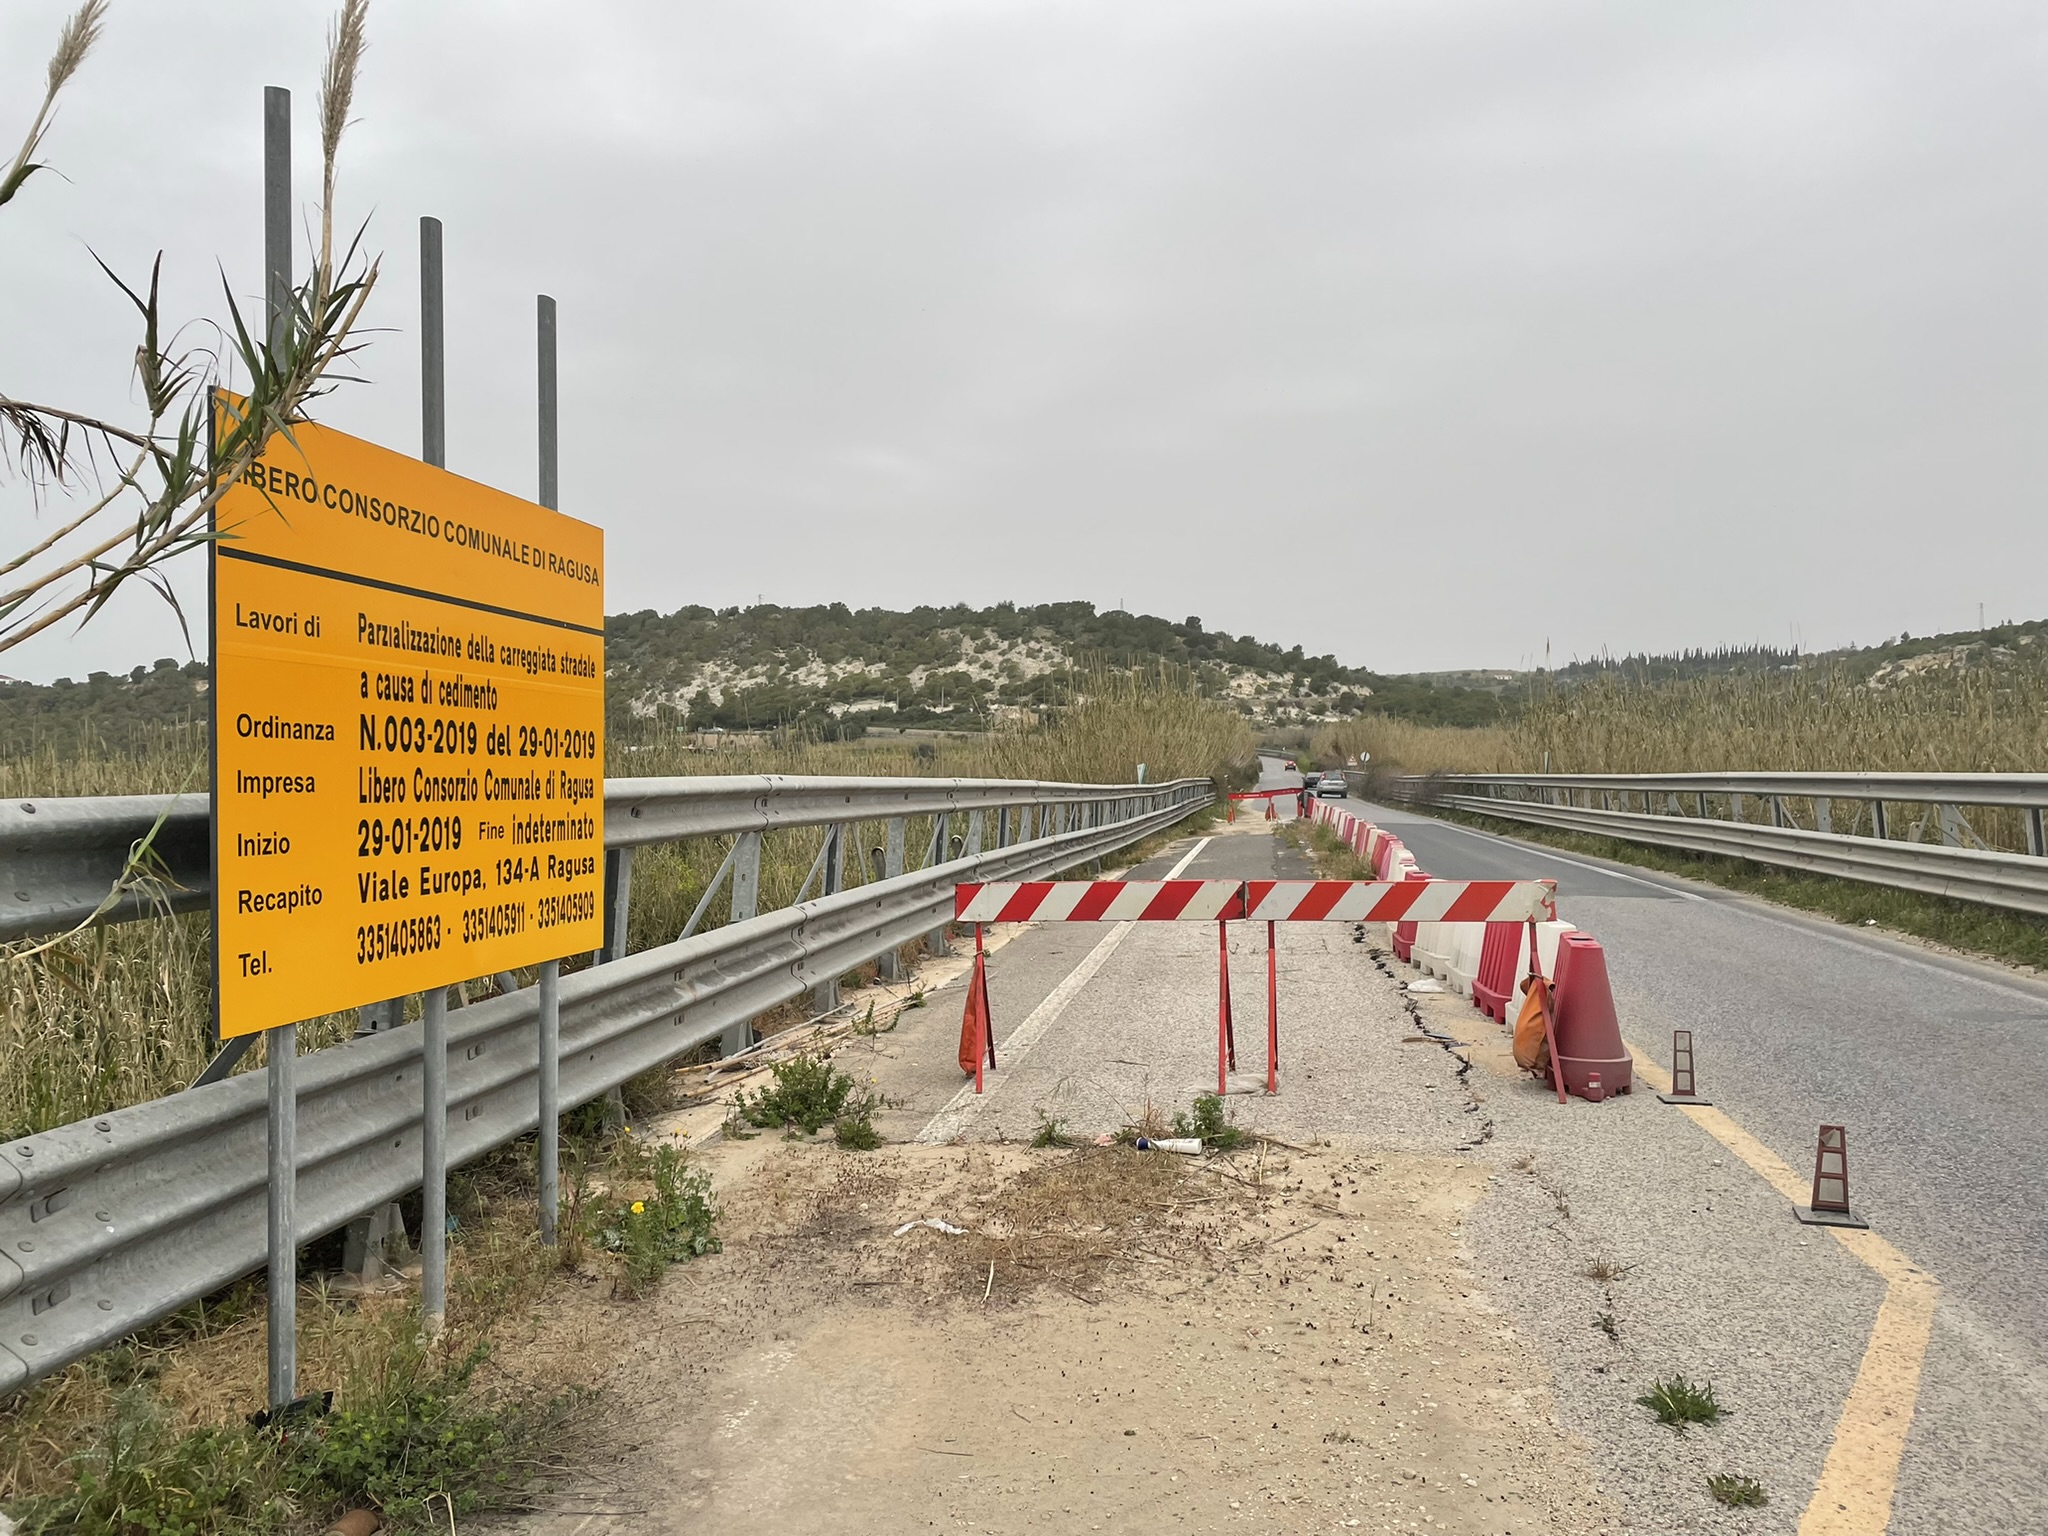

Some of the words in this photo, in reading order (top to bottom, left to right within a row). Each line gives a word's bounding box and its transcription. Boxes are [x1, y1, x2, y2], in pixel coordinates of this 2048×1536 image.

[227, 457, 319, 504] BERO
[323, 483, 440, 539] CONSORZIO
[443, 520, 530, 565] COMUNALE
[532, 547, 546, 570] DI
[548, 552, 599, 587] RAGUSA
[235, 602, 298, 635] Lavori
[304, 613, 321, 638] di
[467, 633, 495, 664] della
[500, 645, 557, 675] carreggiata
[560, 651, 596, 679] stradale
[360, 671, 369, 699] a
[376, 672, 415, 703] causa
[438, 673, 498, 711] cedimento
[236, 713, 335, 741] Ordinanza
[359, 713, 478, 757] N.003-2019
[486, 723, 512, 757] del
[518, 725, 596, 760] 29-01-2019
[237, 769, 315, 799] Impresa
[359, 766, 406, 804] Libero
[413, 766, 478, 803] Consorzio
[484, 768, 541, 802] Comunale
[545, 769, 556, 801] di
[560, 770, 594, 806] Ragusa
[237, 831, 291, 858] Inizio
[357, 815, 462, 857] 29-01-2019
[479, 821, 505, 841] Fine
[512, 813, 594, 845] indeterminato
[238, 883, 323, 915] Recapito
[357, 869, 409, 904] Viale
[420, 866, 487, 897] Europa,
[495, 856, 541, 886] 134-A
[547, 854, 595, 883] Ragusa
[357, 913, 441, 965] 3351405863
[462, 901, 525, 944] 3351405911
[537, 890, 595, 929] 3351405909
[238, 949, 273, 978] Tel.
